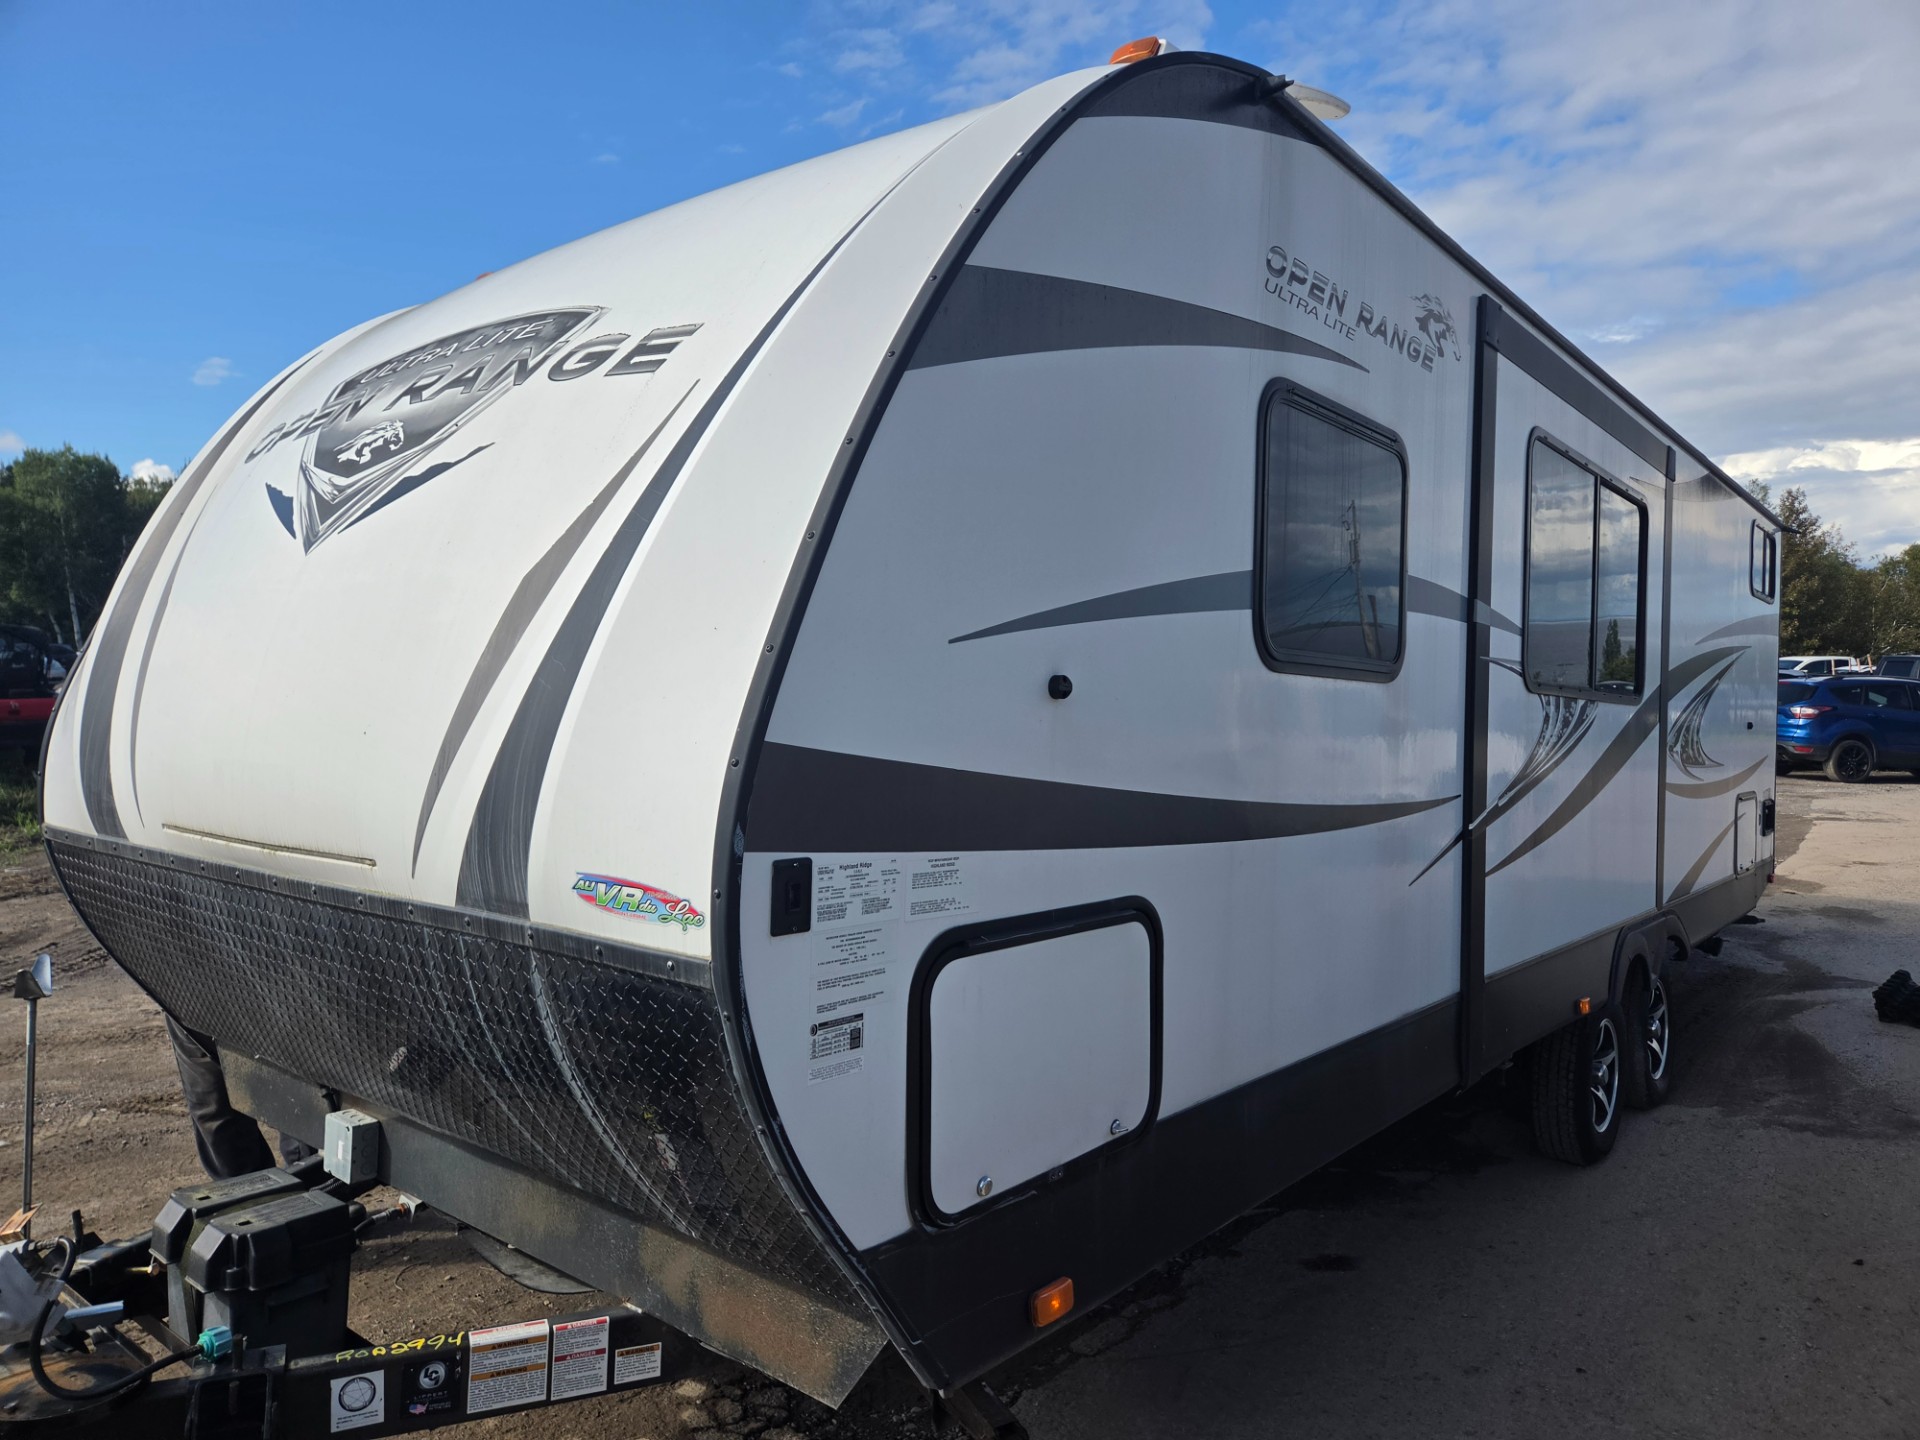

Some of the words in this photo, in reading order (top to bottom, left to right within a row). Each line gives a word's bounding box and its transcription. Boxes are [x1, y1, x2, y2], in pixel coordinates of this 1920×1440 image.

[1264, 278, 1319, 320] ULTRA
[1323, 313, 1357, 341] LITE
[1265, 245, 1349, 317] OPEN
[1355, 301, 1439, 373] RANGE
[360, 344, 459, 384] ULTRA
[465, 318, 555, 353] LITE
[382, 321, 705, 412] RANGE
[839, 863, 859, 871] Highland
[596, 881, 645, 912] VR
[639, 900, 658, 914] du
[658, 899, 704, 931] Lac
[573, 1319, 598, 1328] DANGER
[497, 1339, 529, 1349] WARNING
[571, 1350, 597, 1360] DANGER
[496, 1366, 528, 1377] WARNING
